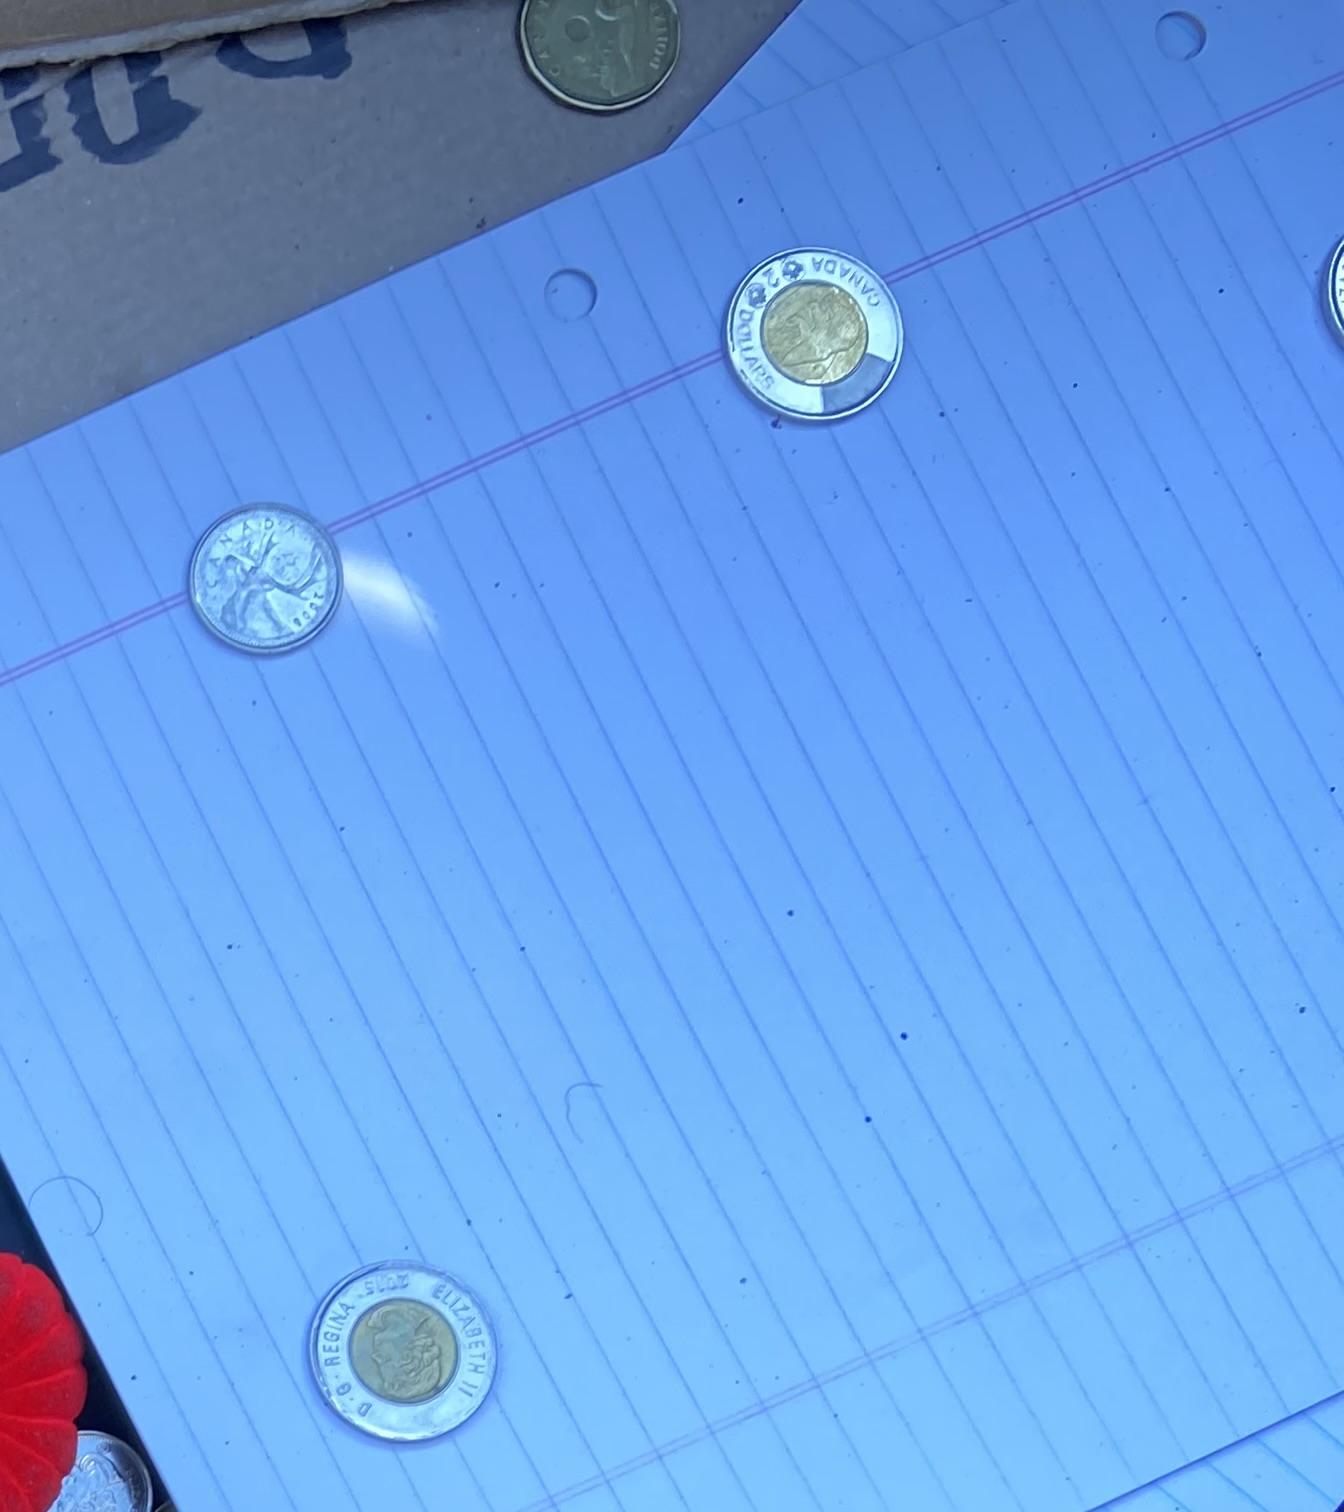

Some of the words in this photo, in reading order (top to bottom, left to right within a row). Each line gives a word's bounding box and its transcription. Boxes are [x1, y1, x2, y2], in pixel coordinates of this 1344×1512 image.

[810, 255, 882, 308] CANADA
[737, 309, 776, 391] DOLLARS
[431, 1281, 487, 1376] ELIZABETH
